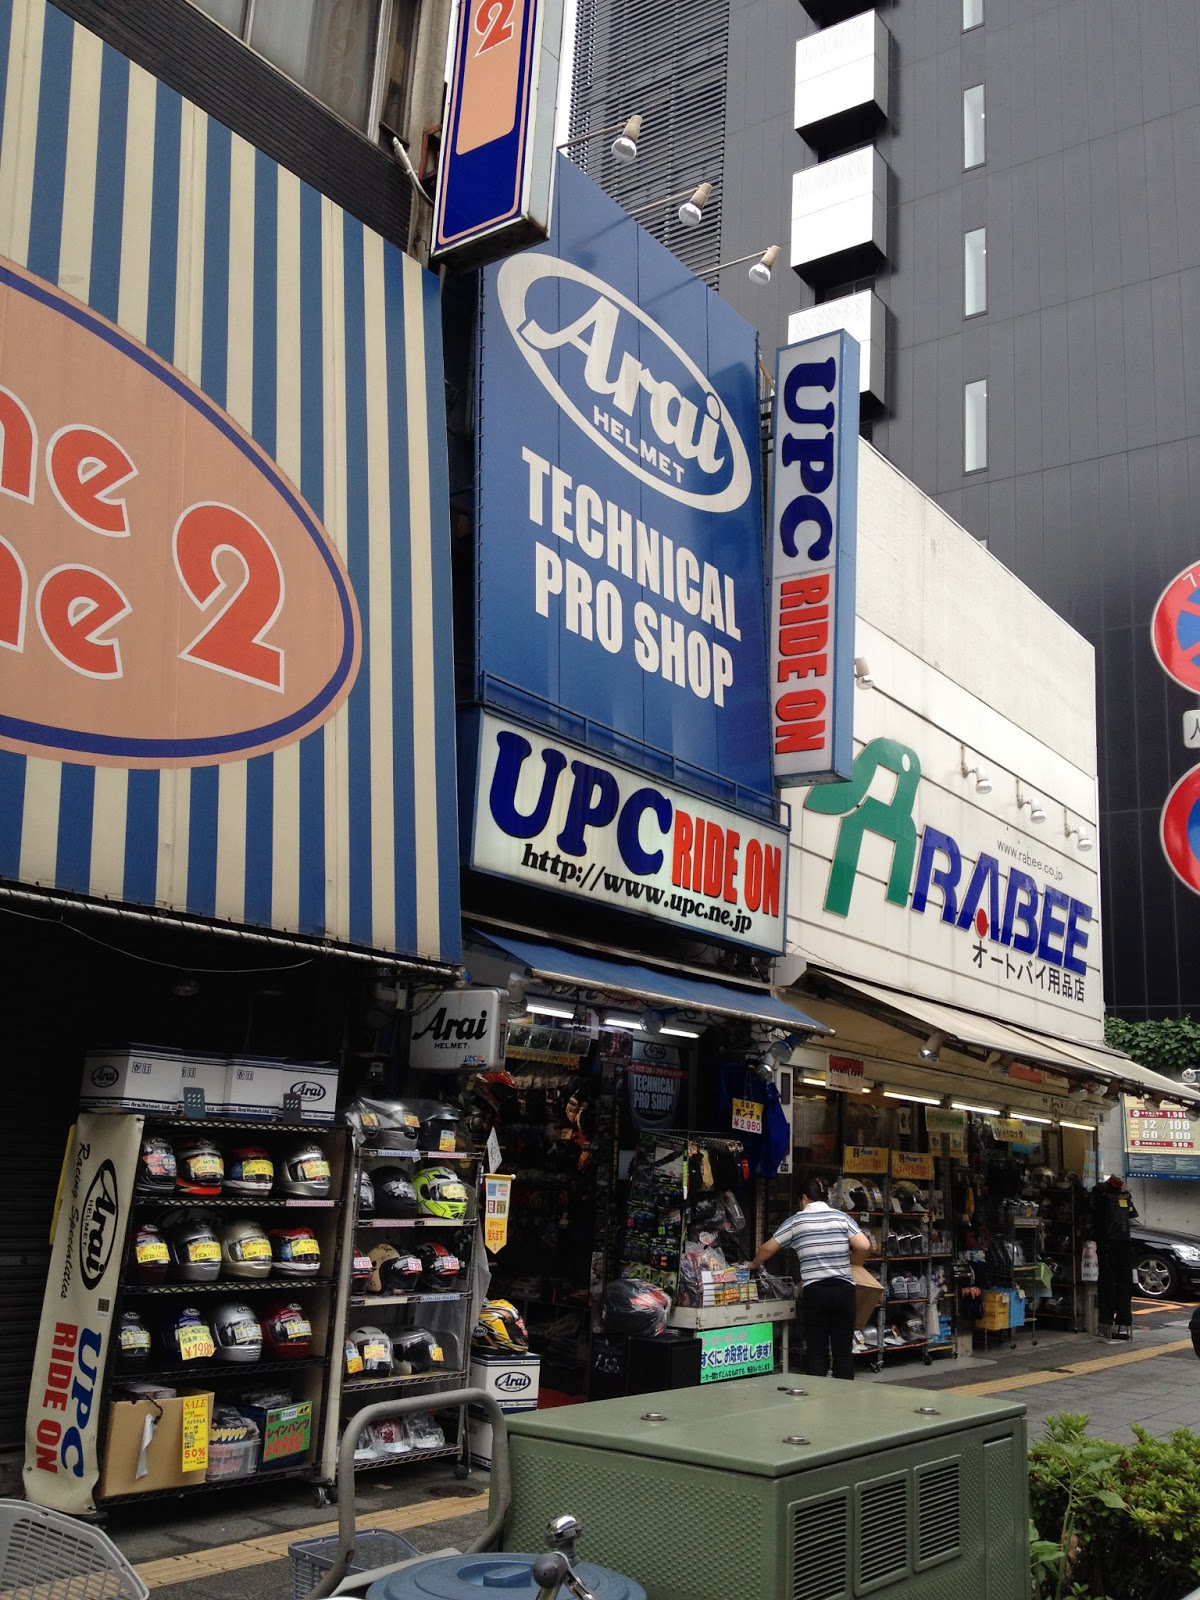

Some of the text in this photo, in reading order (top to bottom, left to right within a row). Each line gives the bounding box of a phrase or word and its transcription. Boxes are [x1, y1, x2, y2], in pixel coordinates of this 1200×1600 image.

[520, 295, 726, 474] Arai
[593, 405, 685, 484] HELMET
[521, 446, 742, 642] TECHNICAL
[774, 356, 836, 755] UPC RIDE ON
[172, 501, 285, 694] 2
[535, 541, 733, 708] PRO SHOP
[489, 730, 781, 918] UPC RIDE ON
[521, 843, 753, 934] http://www.upc.ne.jp
[997, 838, 1064, 882] www.rabee.co.jp
[972, 940, 1086, 1003] オートバイ用品店
[411, 1007, 488, 1041] Arai
[91, 1066, 118, 1084] Arai
[293, 1082, 324, 1098] Arai
[633, 1074, 675, 1095] TECHNICAL
[633, 1091, 673, 1112] PRO SHOP
[740, 1100, 755, 1110] SBK
[61, 1142, 91, 1300] Racing Specialties
[82, 1199, 95, 1251] HELMET
[86, 1167, 117, 1274] Arai
[36, 1321, 79, 1474] RIDE ON
[60, 1328, 102, 1478] UPC
[184, 1399, 207, 1410] SALE
[498, 1375, 528, 1387] Arai
[184, 1447, 206, 1459] 50%
[267, 1418, 310, 1438] レインパンツ
